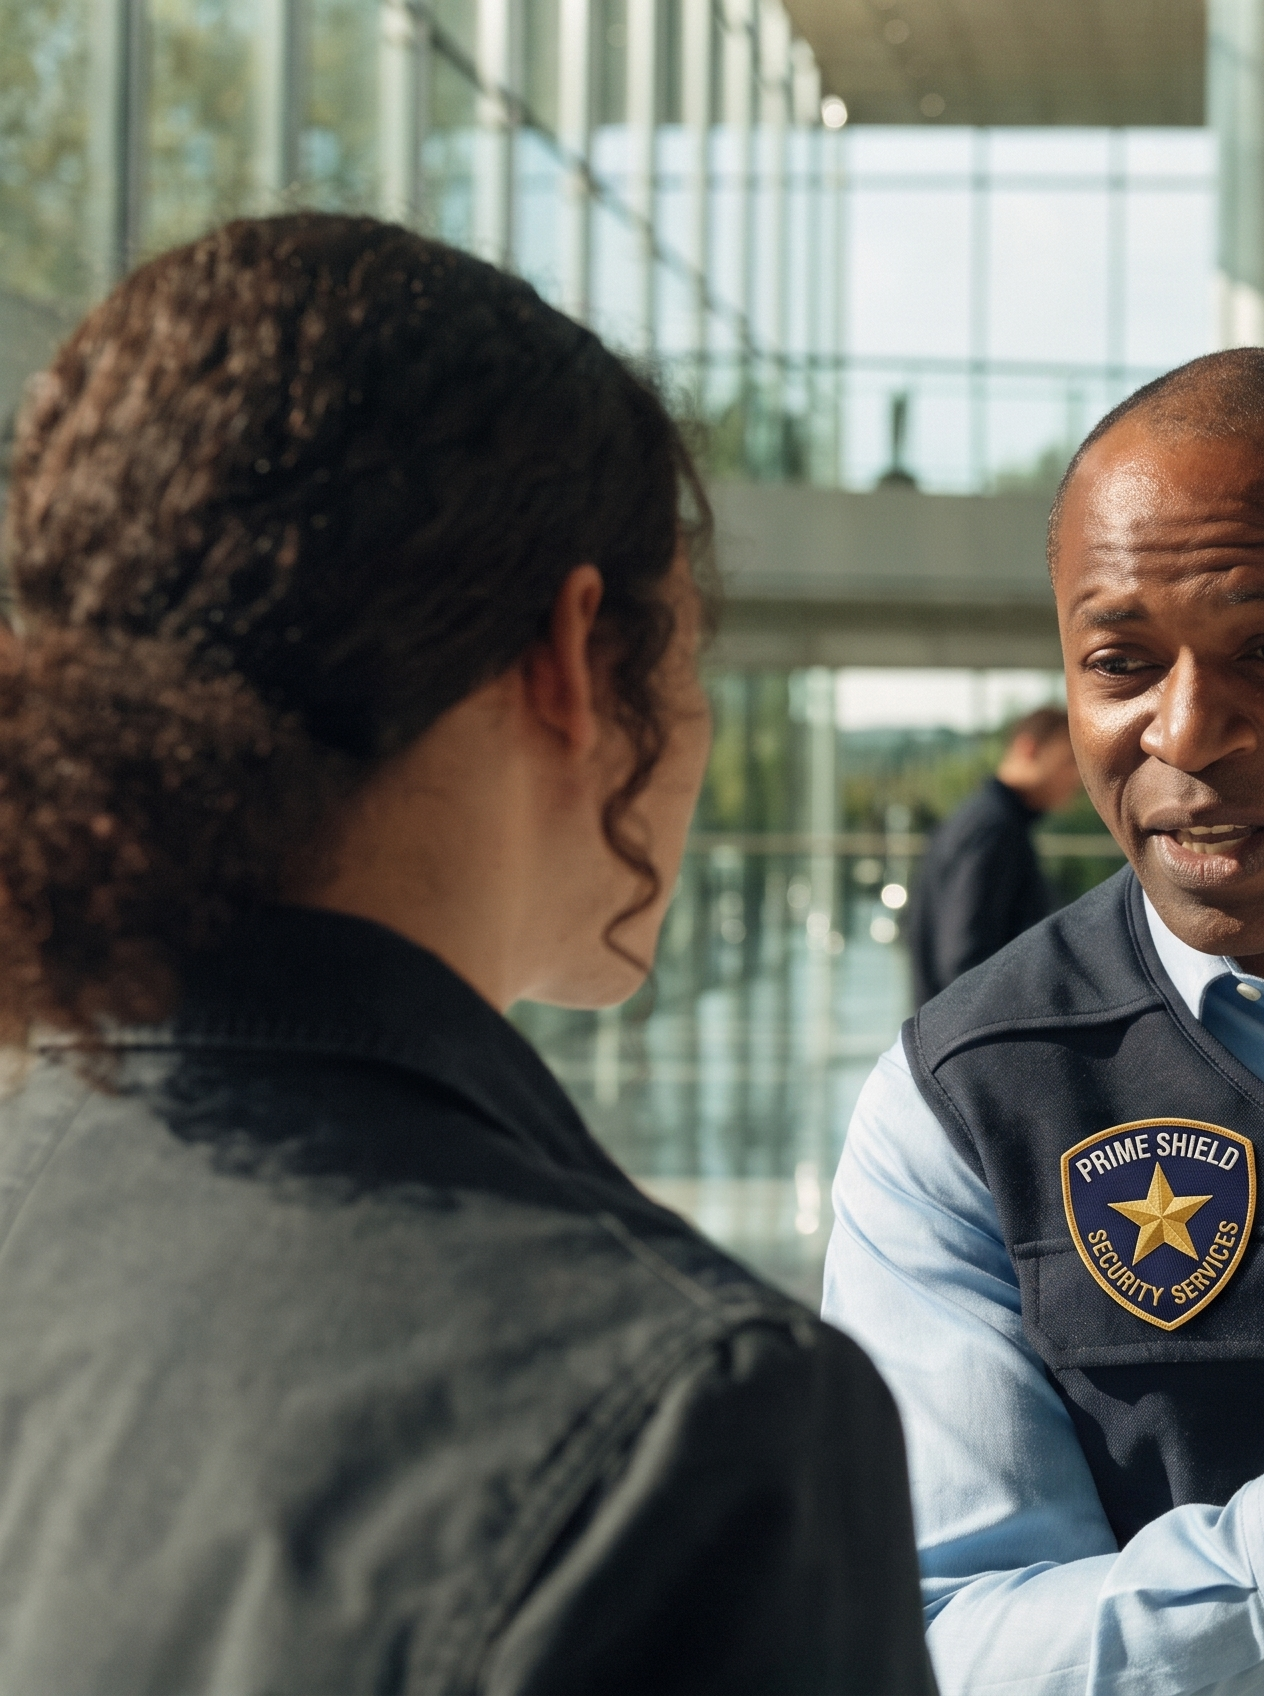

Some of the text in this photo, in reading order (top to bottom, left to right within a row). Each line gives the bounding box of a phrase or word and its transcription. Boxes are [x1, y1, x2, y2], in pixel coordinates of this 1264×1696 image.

[1076, 1132, 1240, 1183] PRIME SHIELD
[1088, 1220, 1239, 1306] SECURITY SERVICES
